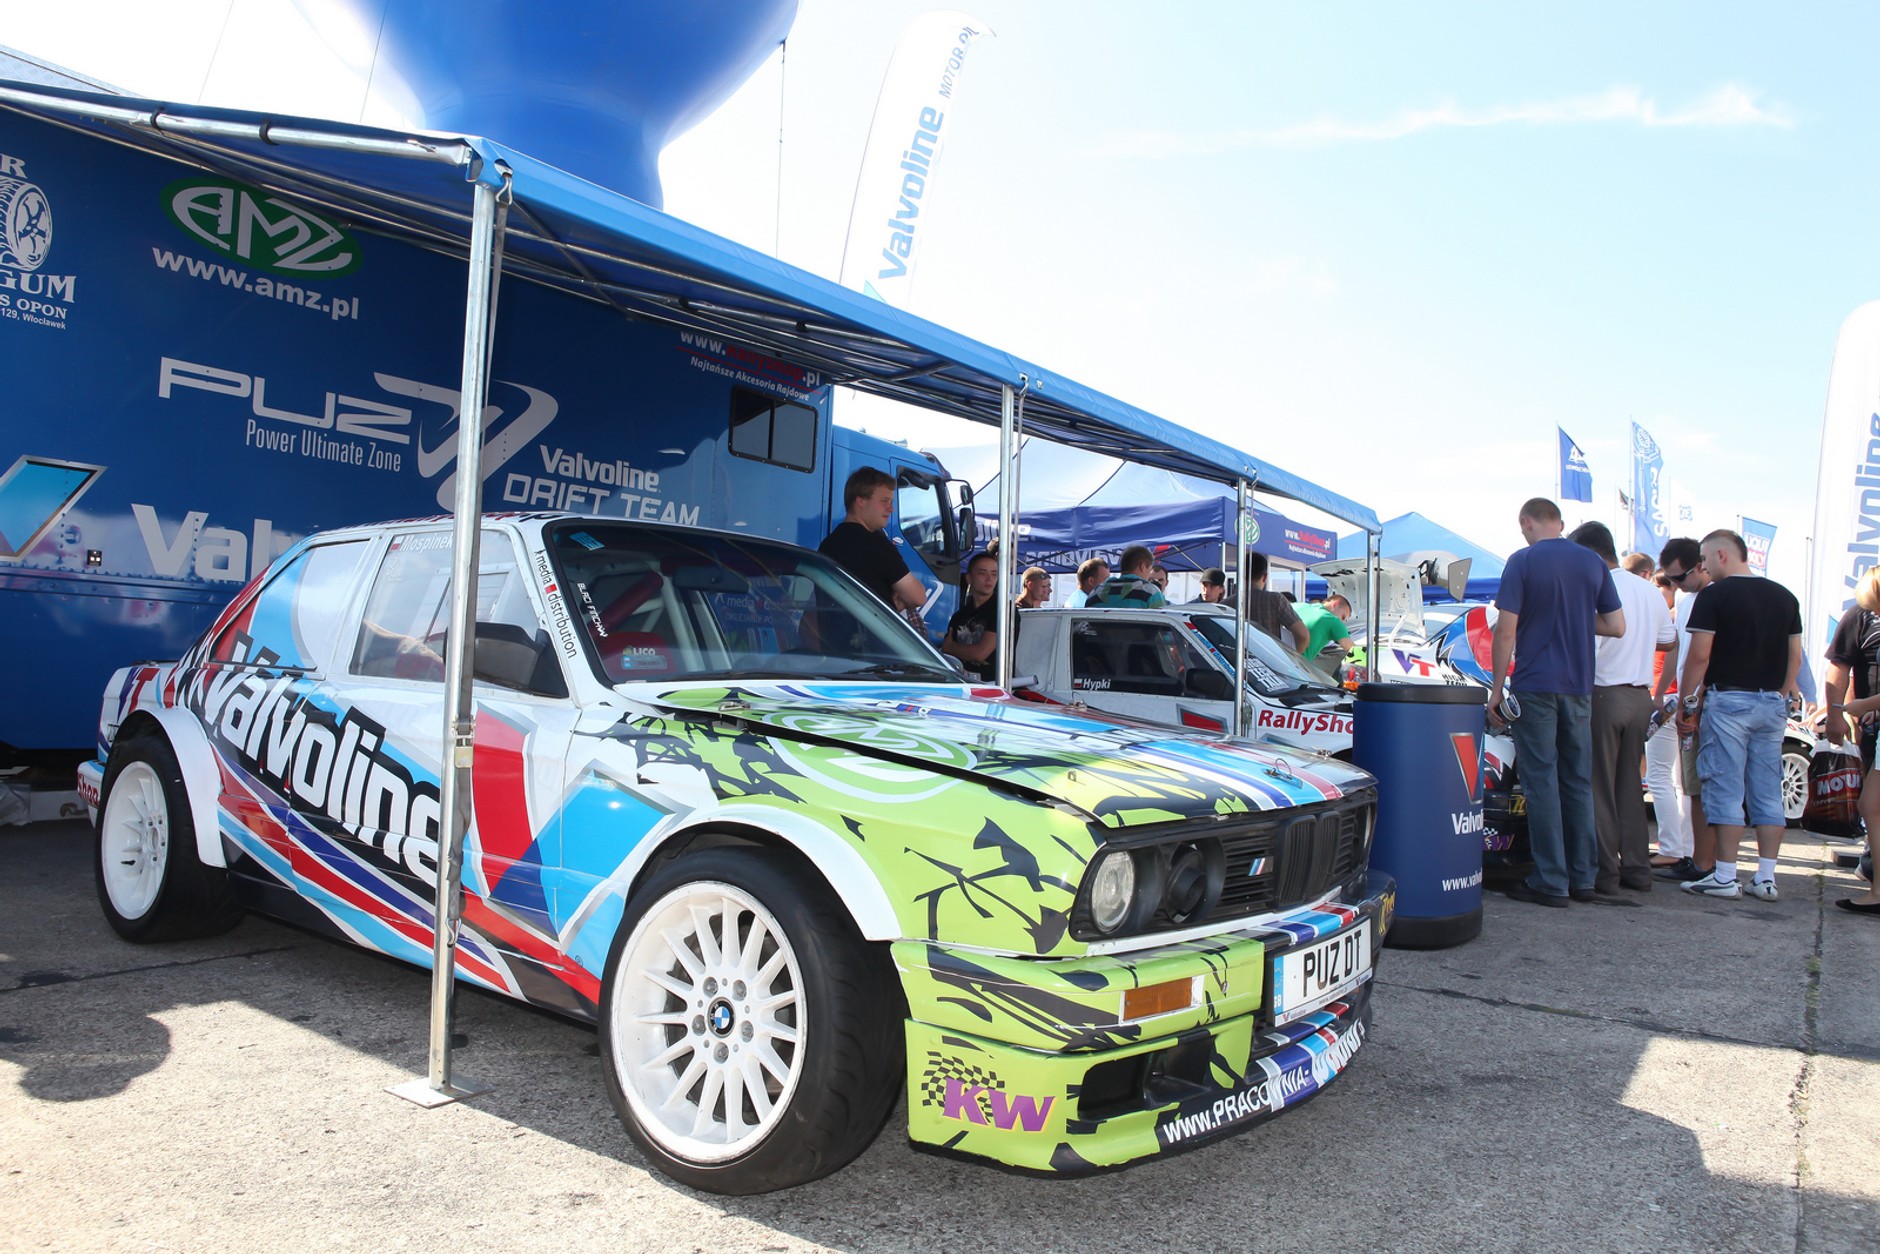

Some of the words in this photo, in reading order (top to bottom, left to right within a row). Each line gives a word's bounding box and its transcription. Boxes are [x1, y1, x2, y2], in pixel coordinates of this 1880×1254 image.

[938, 46, 964, 99] MOTOR
[878, 106, 945, 279] Valvoline
[172, 186, 353, 271] AMZ
[16, 298, 68, 320] OPON
[152, 247, 359, 320] www.amz.pl
[735, 371, 776, 391] Akcesoria
[776, 383, 810, 401] Rajdowe
[246, 418, 297, 454] Power
[301, 429, 363, 466] Ultimate
[368, 441, 401, 472] Zone
[503, 472, 610, 515] DRIFT
[620, 492, 700, 526] TEAM
[537, 554, 553, 585] media
[547, 592, 578, 659] distribution
[1083, 679, 1111, 691] Hypki
[1303, 940, 1340, 998] PUZ
[1344, 929, 1362, 978] DT
[942, 1077, 1056, 1133] KW
